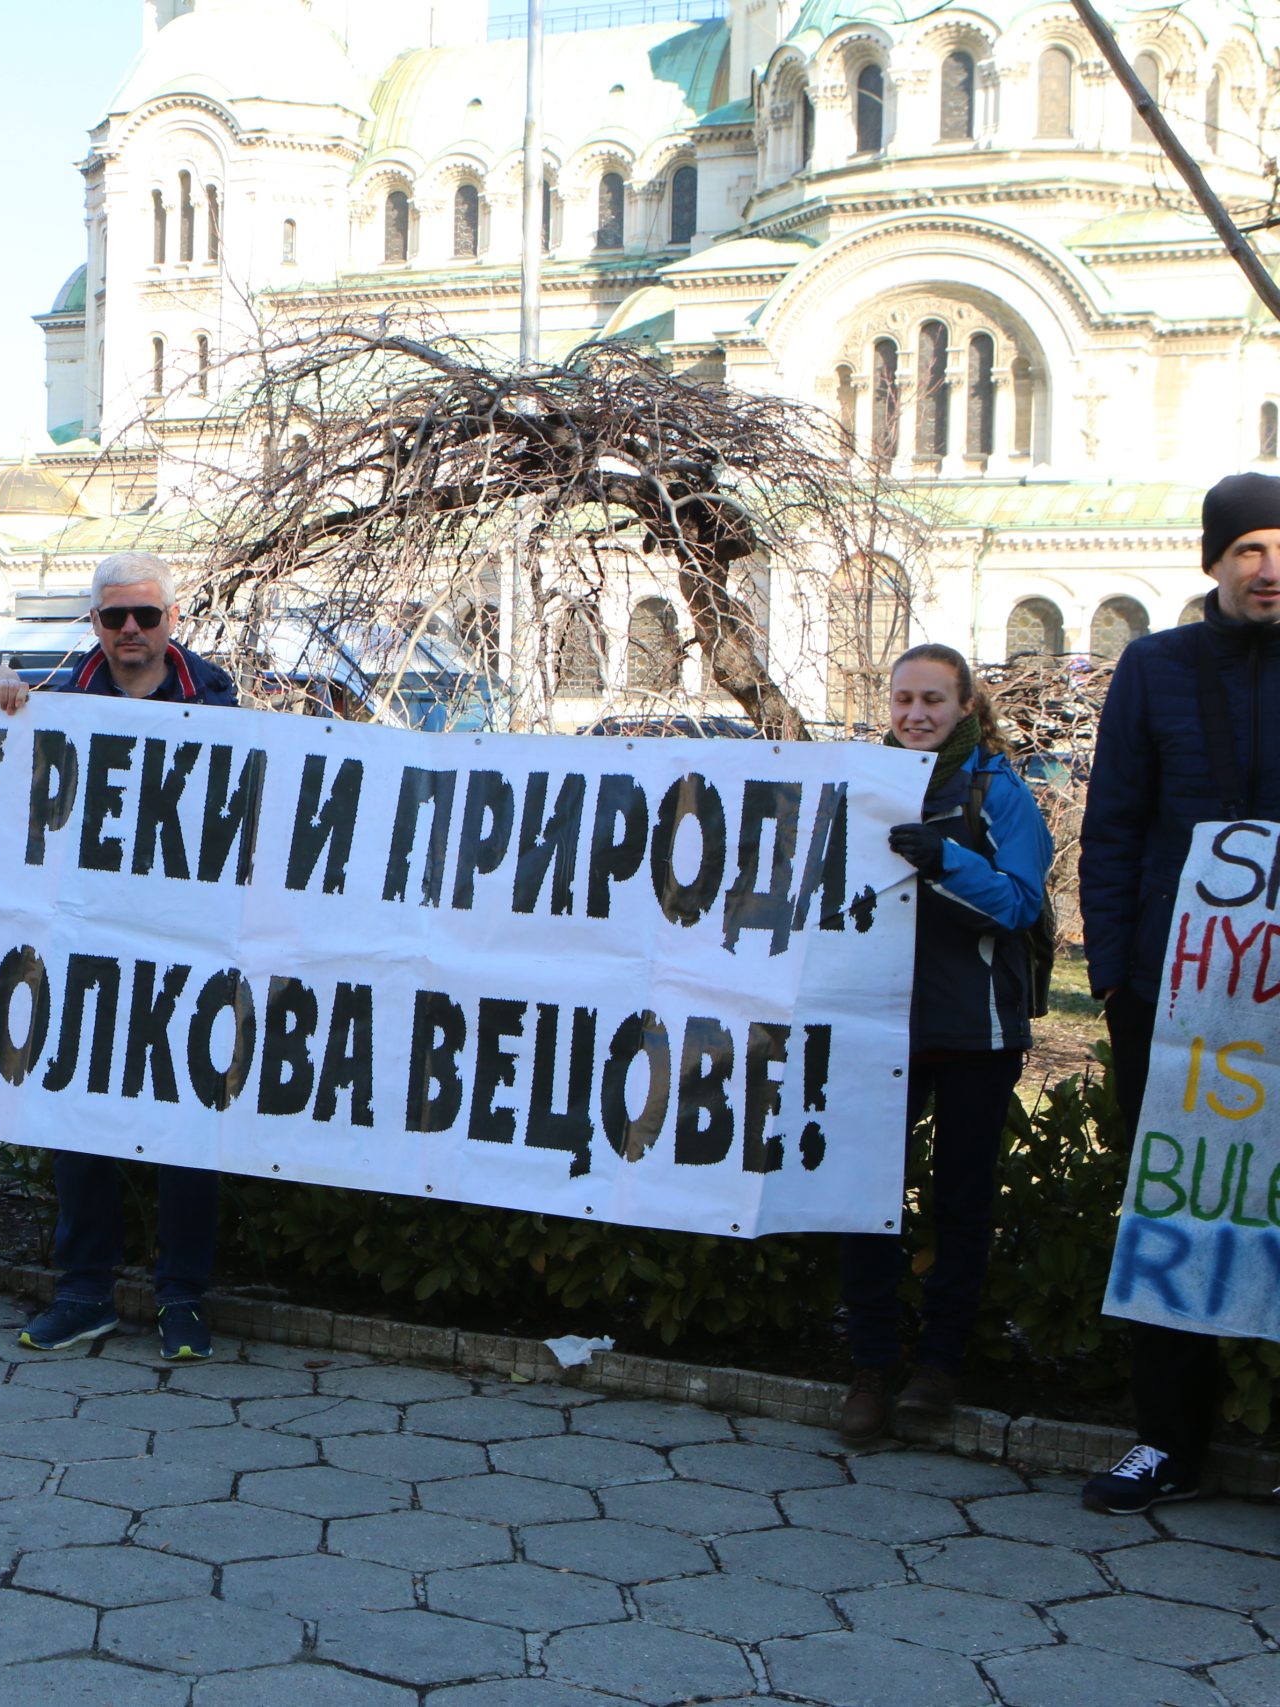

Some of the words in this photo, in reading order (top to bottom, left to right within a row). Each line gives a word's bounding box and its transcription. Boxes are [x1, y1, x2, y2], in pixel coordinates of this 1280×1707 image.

[25, 729, 267, 886] РЕКИ
[285, 753, 364, 894] И
[1196, 822, 1280, 911] S
[405, 989, 832, 1179] ВЕЦОВЕ!
[1184, 1036, 1265, 1119] IS
[1134, 1131, 1280, 1228] BUL
[1113, 1216, 1280, 1317] RI
